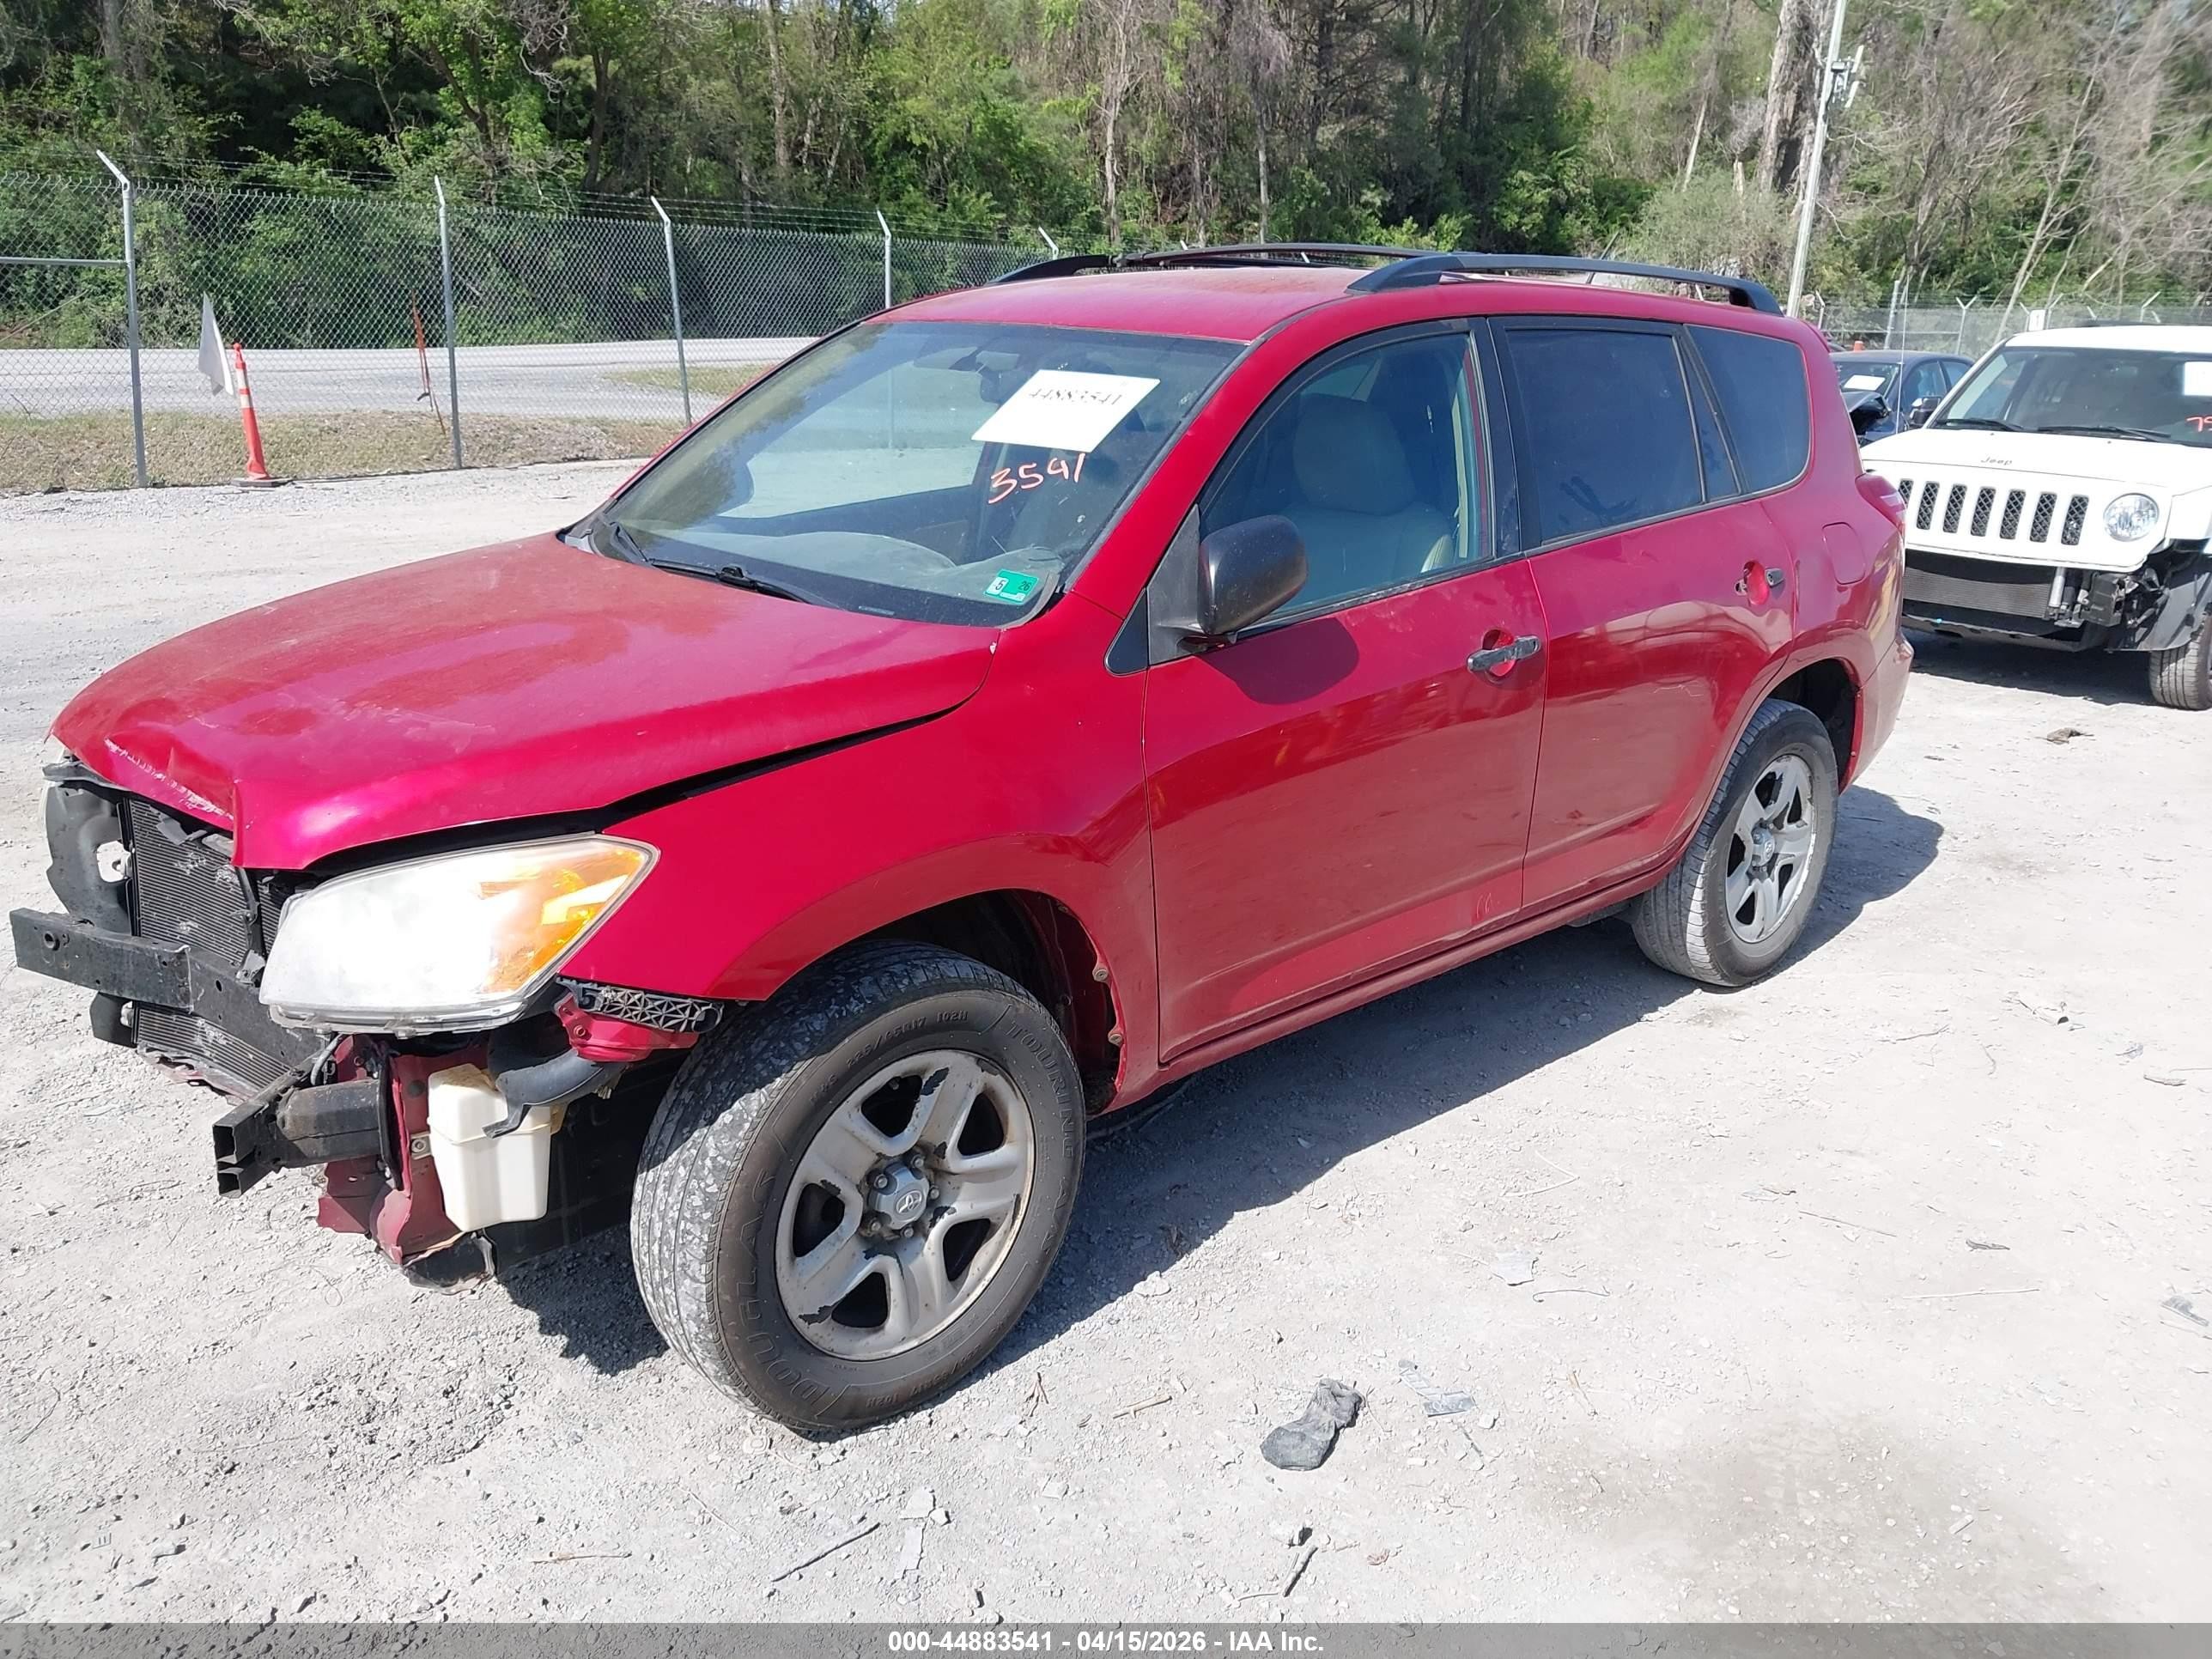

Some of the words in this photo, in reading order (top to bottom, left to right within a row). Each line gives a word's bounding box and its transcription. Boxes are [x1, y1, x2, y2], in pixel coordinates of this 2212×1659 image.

[1980, 456, 2013, 466] Jeep
[988, 453, 1086, 504] 3591
[1018, 580, 1032, 592] 26
[936, 1010, 969, 1024] 102H
[1006, 1020, 1074, 1158] TOURING
[737, 1168, 830, 1406] DOUGLAS
